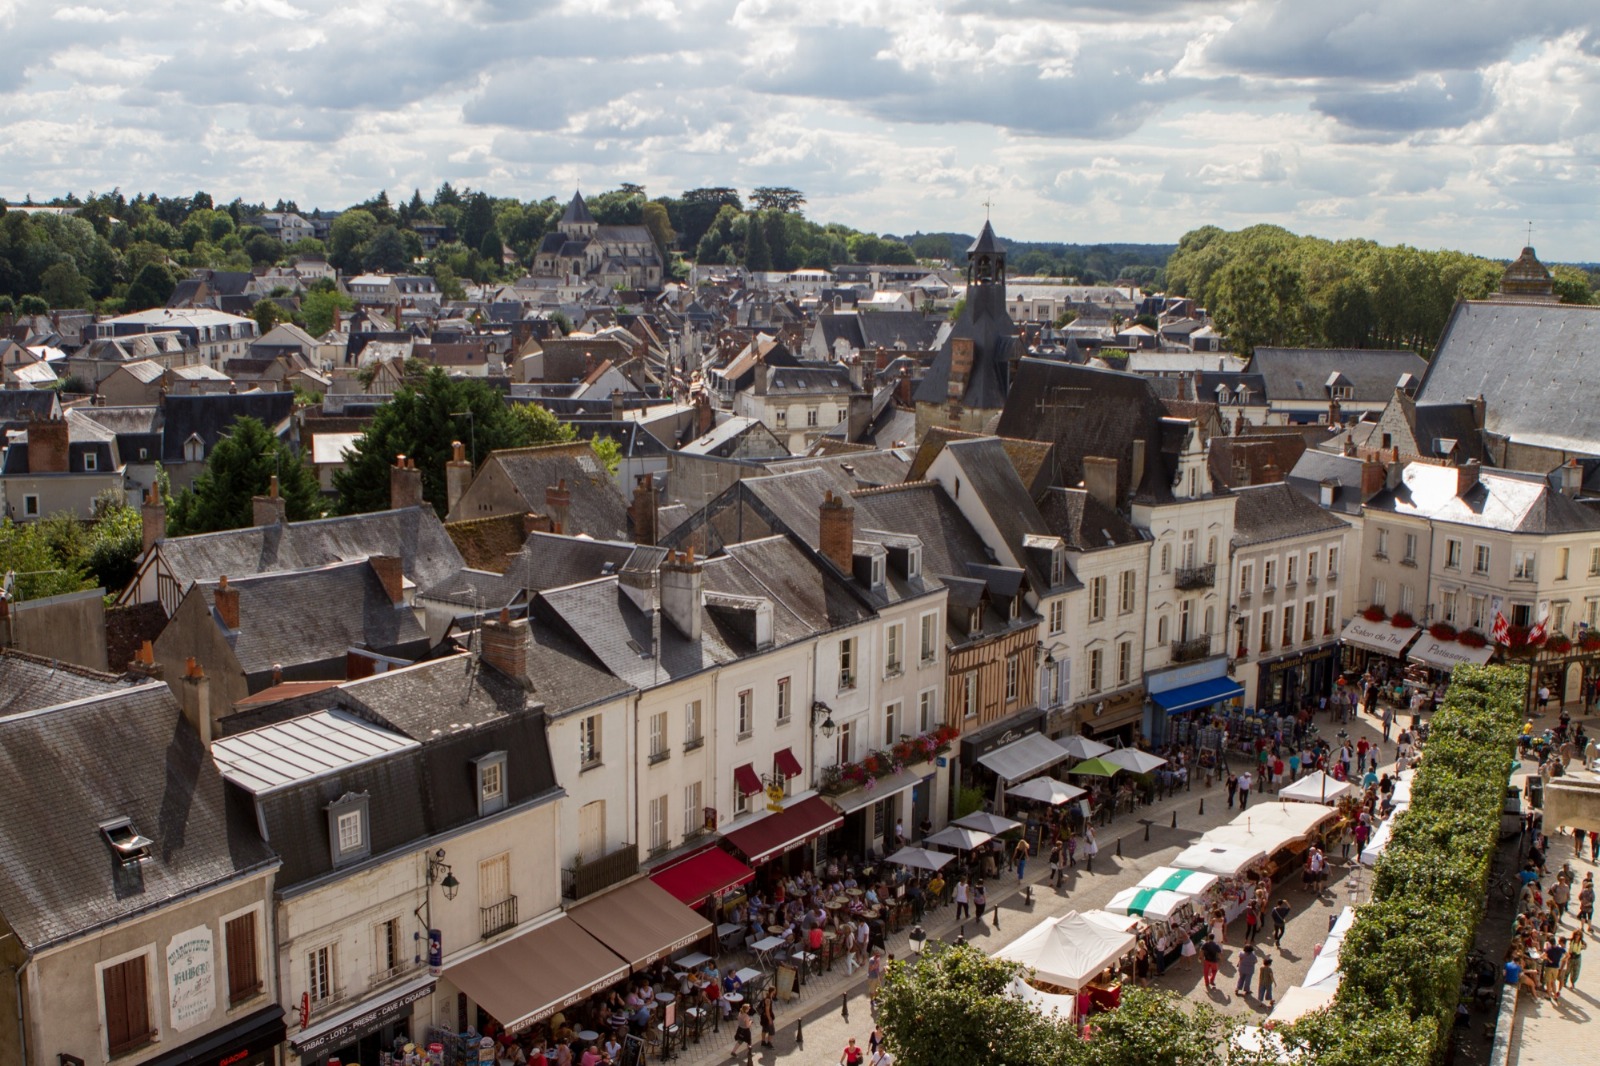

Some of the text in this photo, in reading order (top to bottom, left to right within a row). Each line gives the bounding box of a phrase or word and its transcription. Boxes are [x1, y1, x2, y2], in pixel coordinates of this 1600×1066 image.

[1350, 625, 1374, 638] Salon
[1374, 632, 1386, 641] de
[760, 855, 770, 864] BAR
[671, 934, 699, 952] PIZZERIA
[646, 952, 660, 964] BAR
[591, 972, 625, 993] SALADERIE
[563, 993, 583, 1007] GRILL
[302, 1037, 325, 1053] TABAC
[329, 1026, 348, 1041] LOTO
[352, 1012, 377, 1030] PRESSE
[381, 1001, 399, 1016] CAVE
[399, 999, 404, 1007] A
[404, 987, 432, 1005] CIGARES
[511, 1006, 555, 1032] RESTAURANT
